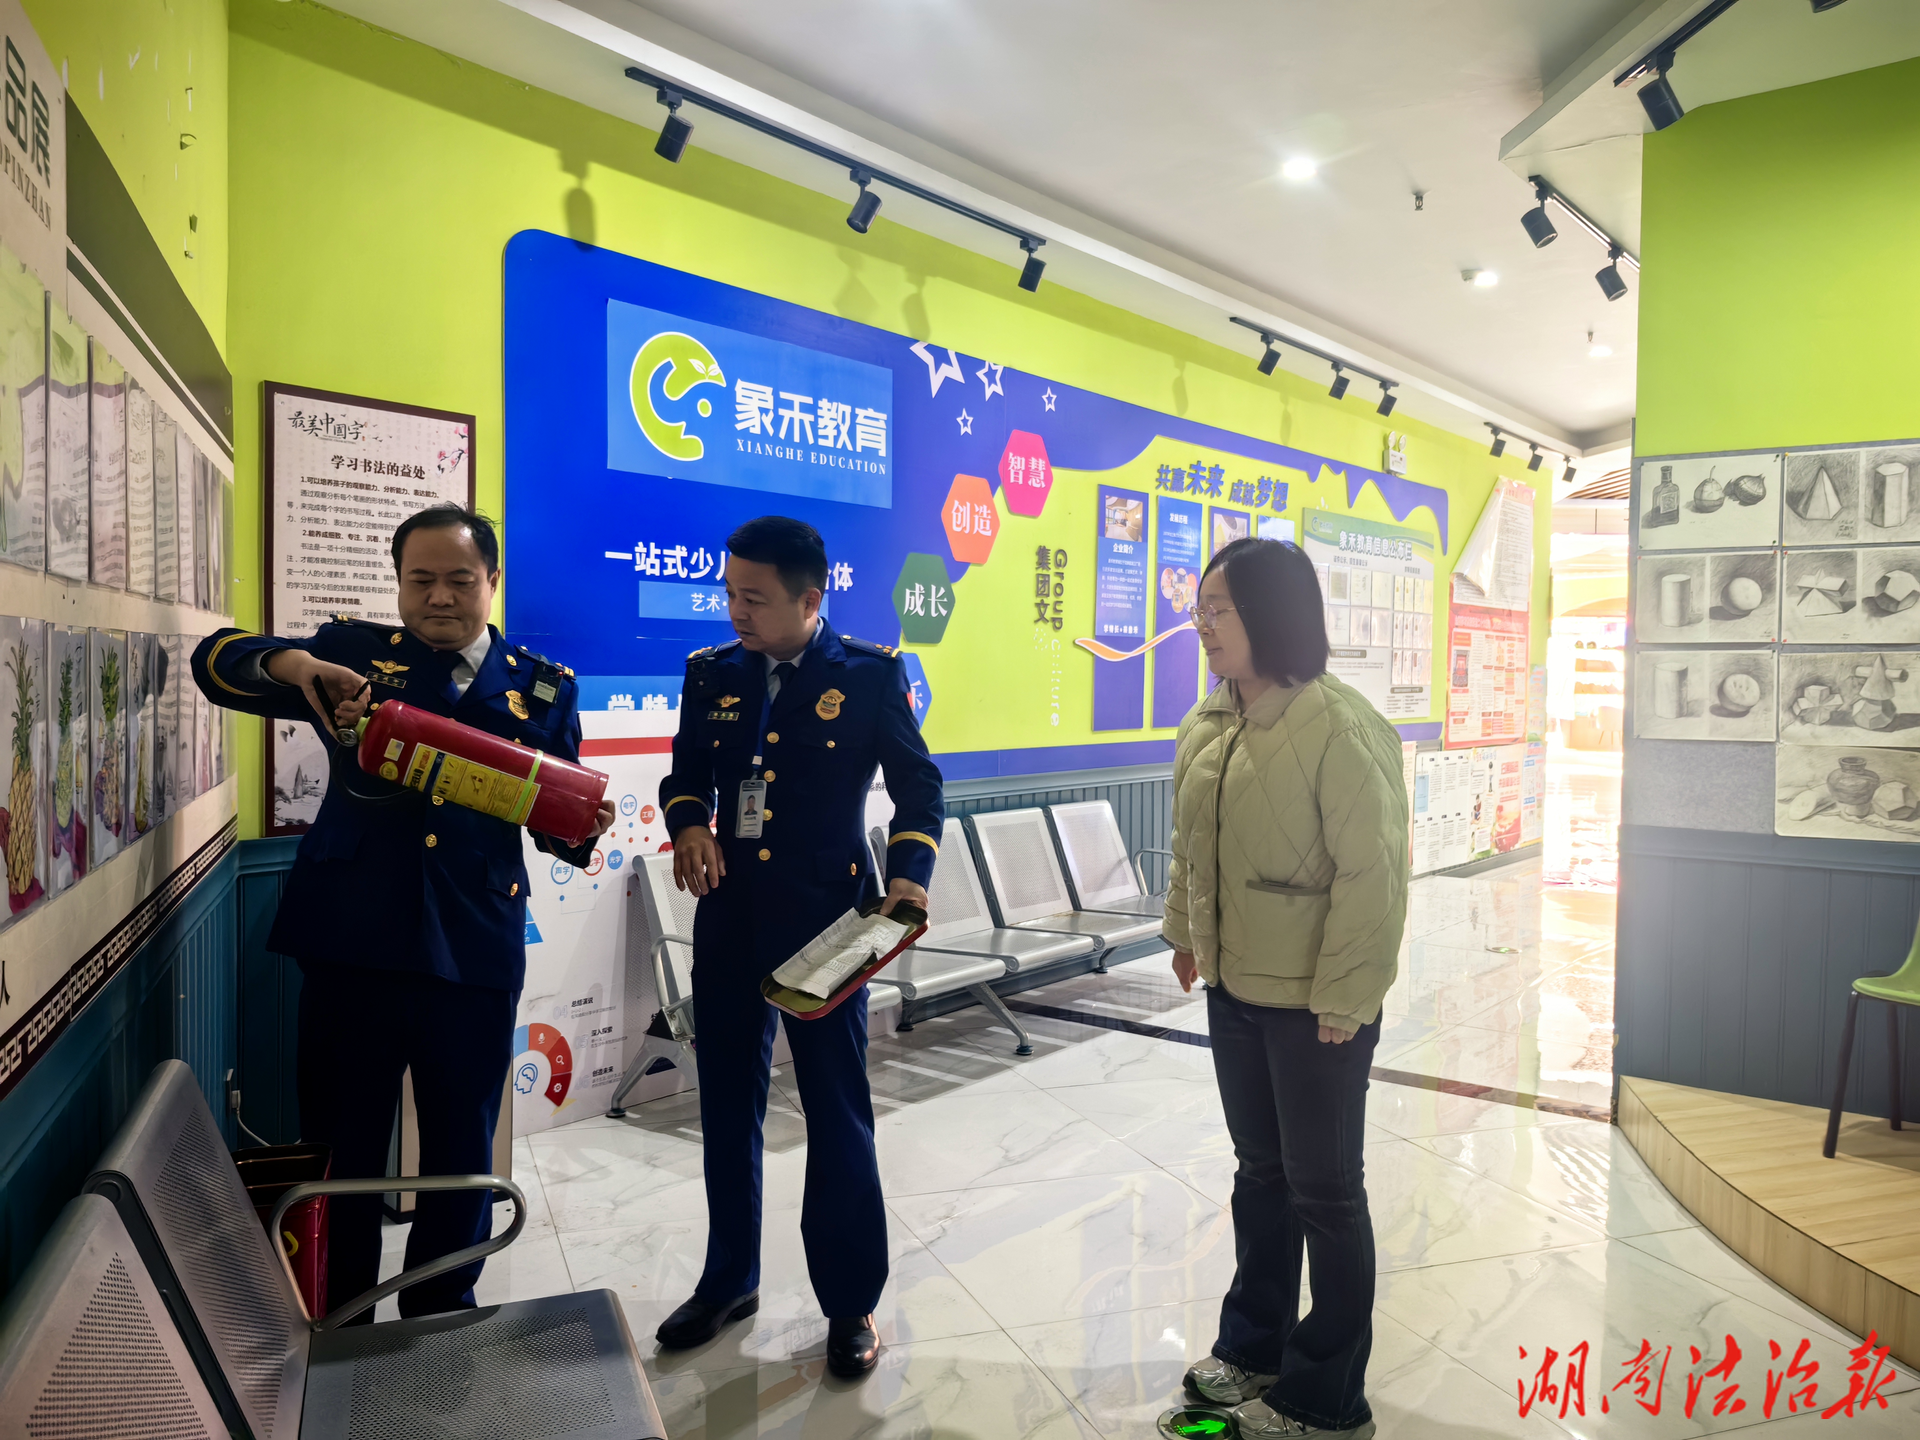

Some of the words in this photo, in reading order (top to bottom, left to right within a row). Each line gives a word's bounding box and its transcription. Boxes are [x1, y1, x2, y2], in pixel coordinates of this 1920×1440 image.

[734, 378, 888, 457] 象禾教育
[331, 454, 426, 480] 学习书法的益处
[736, 438, 804, 462] XIANGHE
[810, 451, 887, 475] EDUCATION
[1007, 451, 1047, 489] 智慧
[1155, 460, 1225, 498] 共赢未来
[1228, 475, 1289, 512] 成就梦想
[951, 499, 993, 537] 创造
[301, 542, 392, 557] 书法是一项十分精细的活动，要
[903, 582, 949, 618] 成长
[1033, 545, 1051, 625] 集团文
[1050, 548, 1068, 631] Group
[642, 811, 654, 819] 工程
[555, 865, 571, 876] 声学
